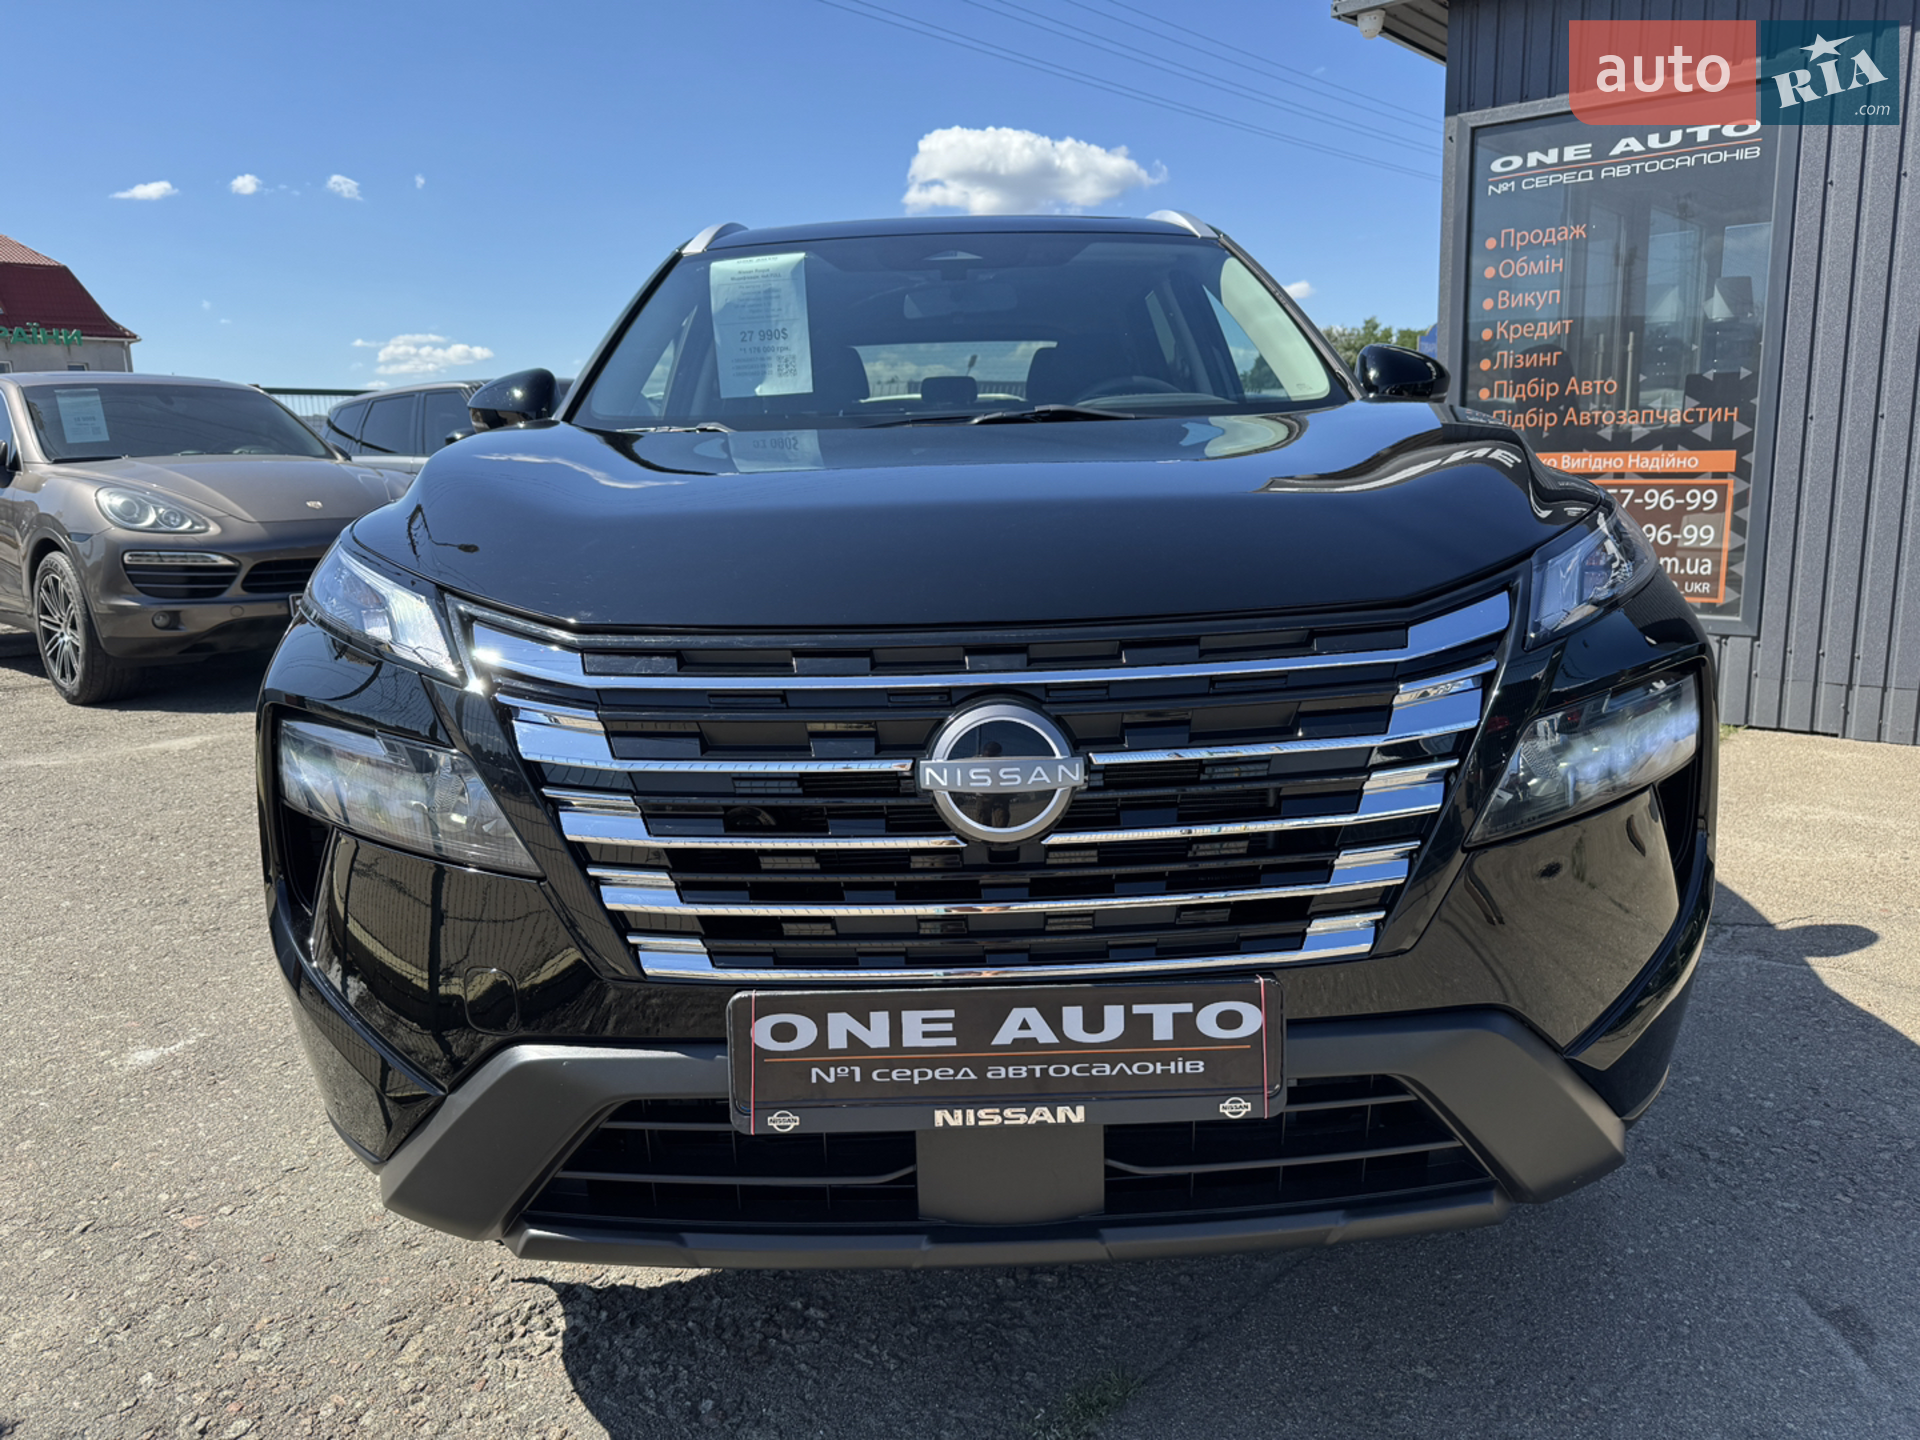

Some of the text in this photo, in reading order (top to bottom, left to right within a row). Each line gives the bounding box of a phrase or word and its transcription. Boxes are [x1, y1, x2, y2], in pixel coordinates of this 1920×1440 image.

[1490, 119, 1761, 173] ONE AUTO
[1500, 223, 1587, 251] Продаж
[1498, 255, 1564, 279] Обмін
[1497, 289, 1561, 311] Викуп
[740, 327, 789, 342] 27 990$
[1496, 319, 1574, 344] Кредит
[1493, 350, 1562, 370] Лізинг
[1493, 376, 1618, 402] Підбір Авто
[1563, 406, 1739, 426] Автозапчастин
[1561, 454, 1626, 472] Вигідно
[1627, 453, 1699, 471] Надійно
[925, 763, 1080, 787] NISSAN
[750, 1000, 1264, 1051] ONE AUTO
[811, 1057, 1205, 1084] №1 серед автосалонів
[934, 1105, 1085, 1127] NISSAN
